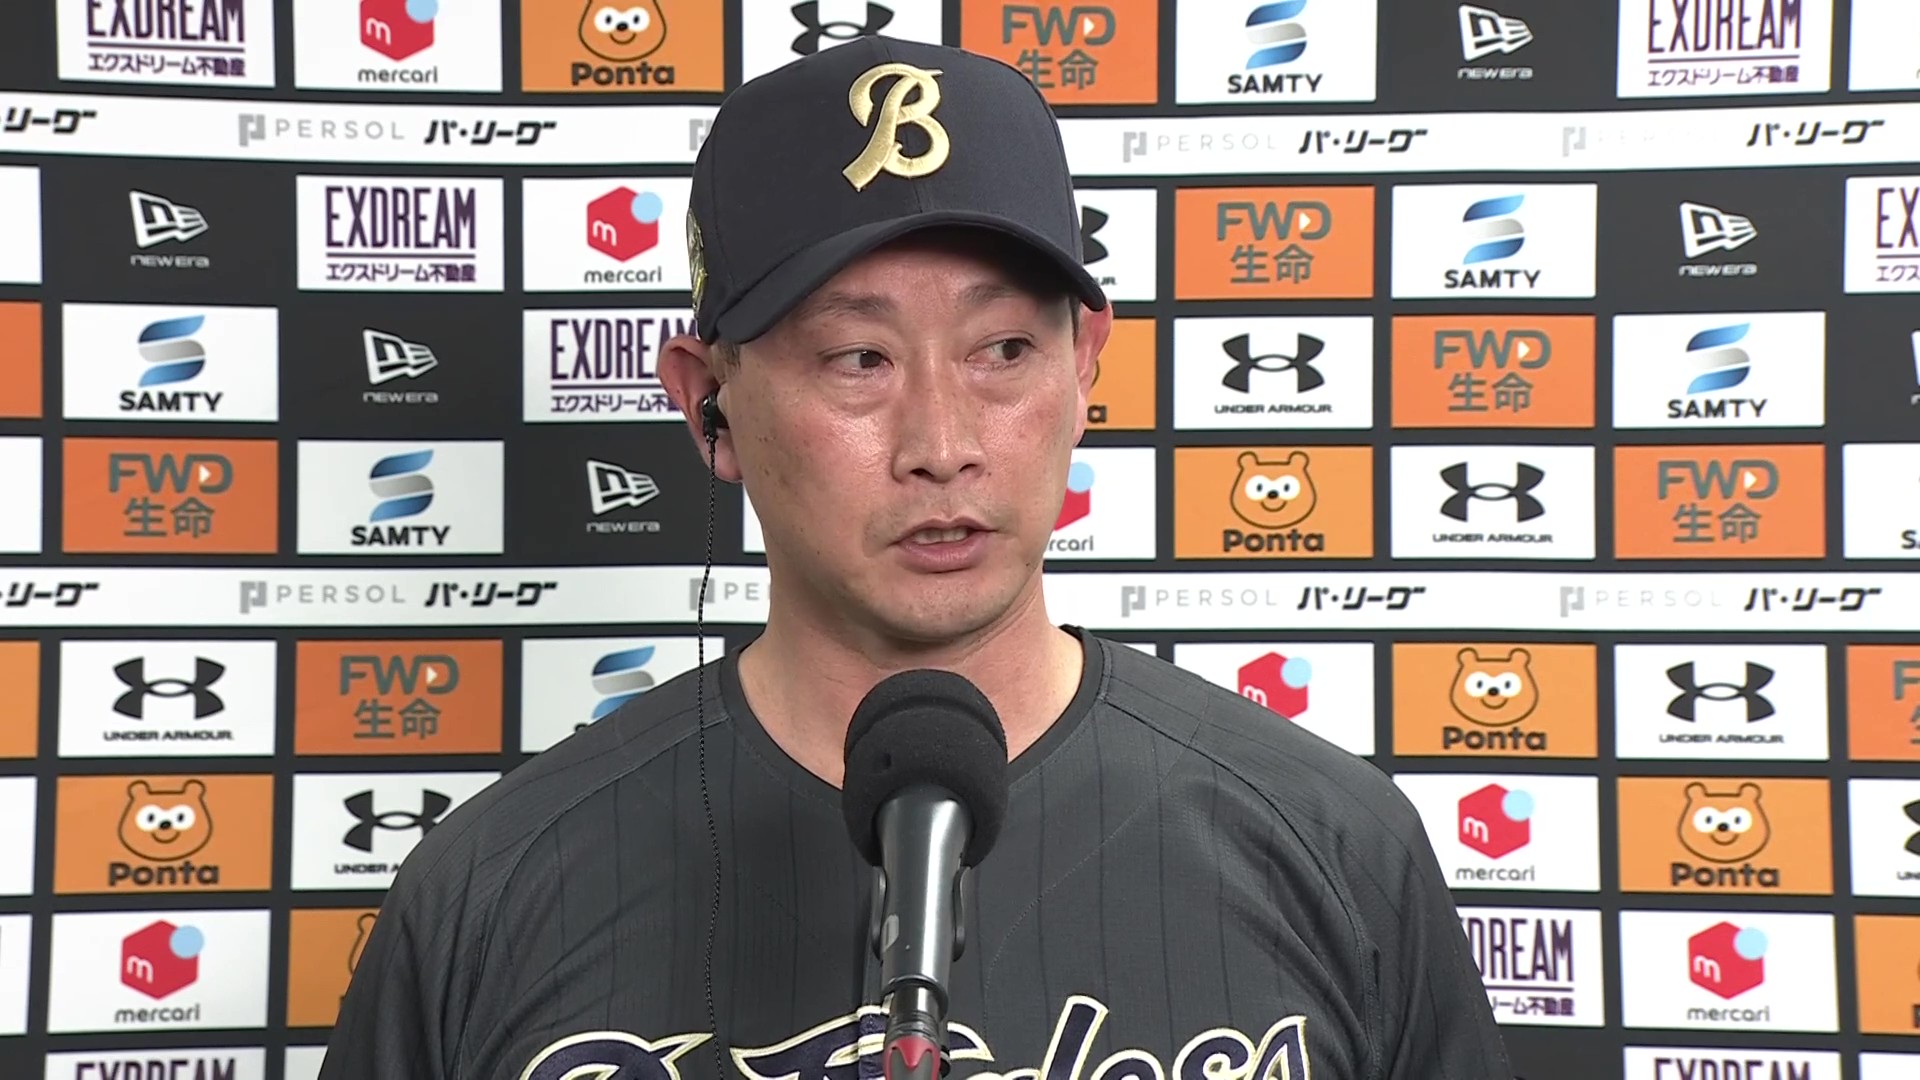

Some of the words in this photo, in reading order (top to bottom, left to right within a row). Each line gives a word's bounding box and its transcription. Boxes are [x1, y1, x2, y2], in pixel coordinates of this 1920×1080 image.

[1003, 5, 1116, 46] FWD
[1648, 0, 1801, 53] EXDREAM
[358, 66, 438, 83] mercari
[571, 62, 674, 86] Ponta
[1228, 74, 1322, 94] SAMTY
[276, 119, 404, 140] PERSOL
[843, 63, 950, 191] B
[1157, 133, 1274, 151] PERSOL
[326, 186, 476, 249] EXDREAM
[1217, 201, 1332, 241] FWD
[584, 266, 661, 283] mercari
[1231, 244, 1313, 284] 生命
[1445, 270, 1540, 288] SAMTY
[1434, 330, 1551, 369] FWD
[120, 391, 222, 412] SAMTY
[551, 393, 682, 412] エクスドリーム不
[1448, 372, 1533, 413] 生命
[1215, 405, 1265, 413] UNDER
[1268, 404, 1329, 413] ARMOUR
[1668, 399, 1766, 418] SAMTY
[109, 453, 233, 494] FWD
[1658, 460, 1779, 500] FWD
[124, 497, 215, 538] 生命
[1673, 502, 1761, 543] 生命
[352, 526, 450, 546] SAMTY
[1223, 528, 1324, 552] Ponta
[1433, 534, 1483, 542] UNDER
[1487, 534, 1551, 543] ARMOUR
[277, 585, 406, 603] PERSOL
[1156, 589, 1277, 607] PERSOL
[340, 655, 459, 695] FWD
[354, 698, 441, 739] 生命
[104, 731, 159, 741] UNDER
[162, 730, 230, 740] ARMOUR
[1443, 726, 1547, 750] Ponta
[1660, 734, 1712, 743] UNDER
[1716, 735, 1780, 743] ARMOUR
[109, 860, 219, 886] Ponta
[335, 863, 388, 874] UNDER
[1456, 866, 1534, 881] mercari
[1671, 860, 1780, 887] Ponta
[115, 1004, 200, 1022] mercari
[1687, 1007, 1769, 1022] mercari
